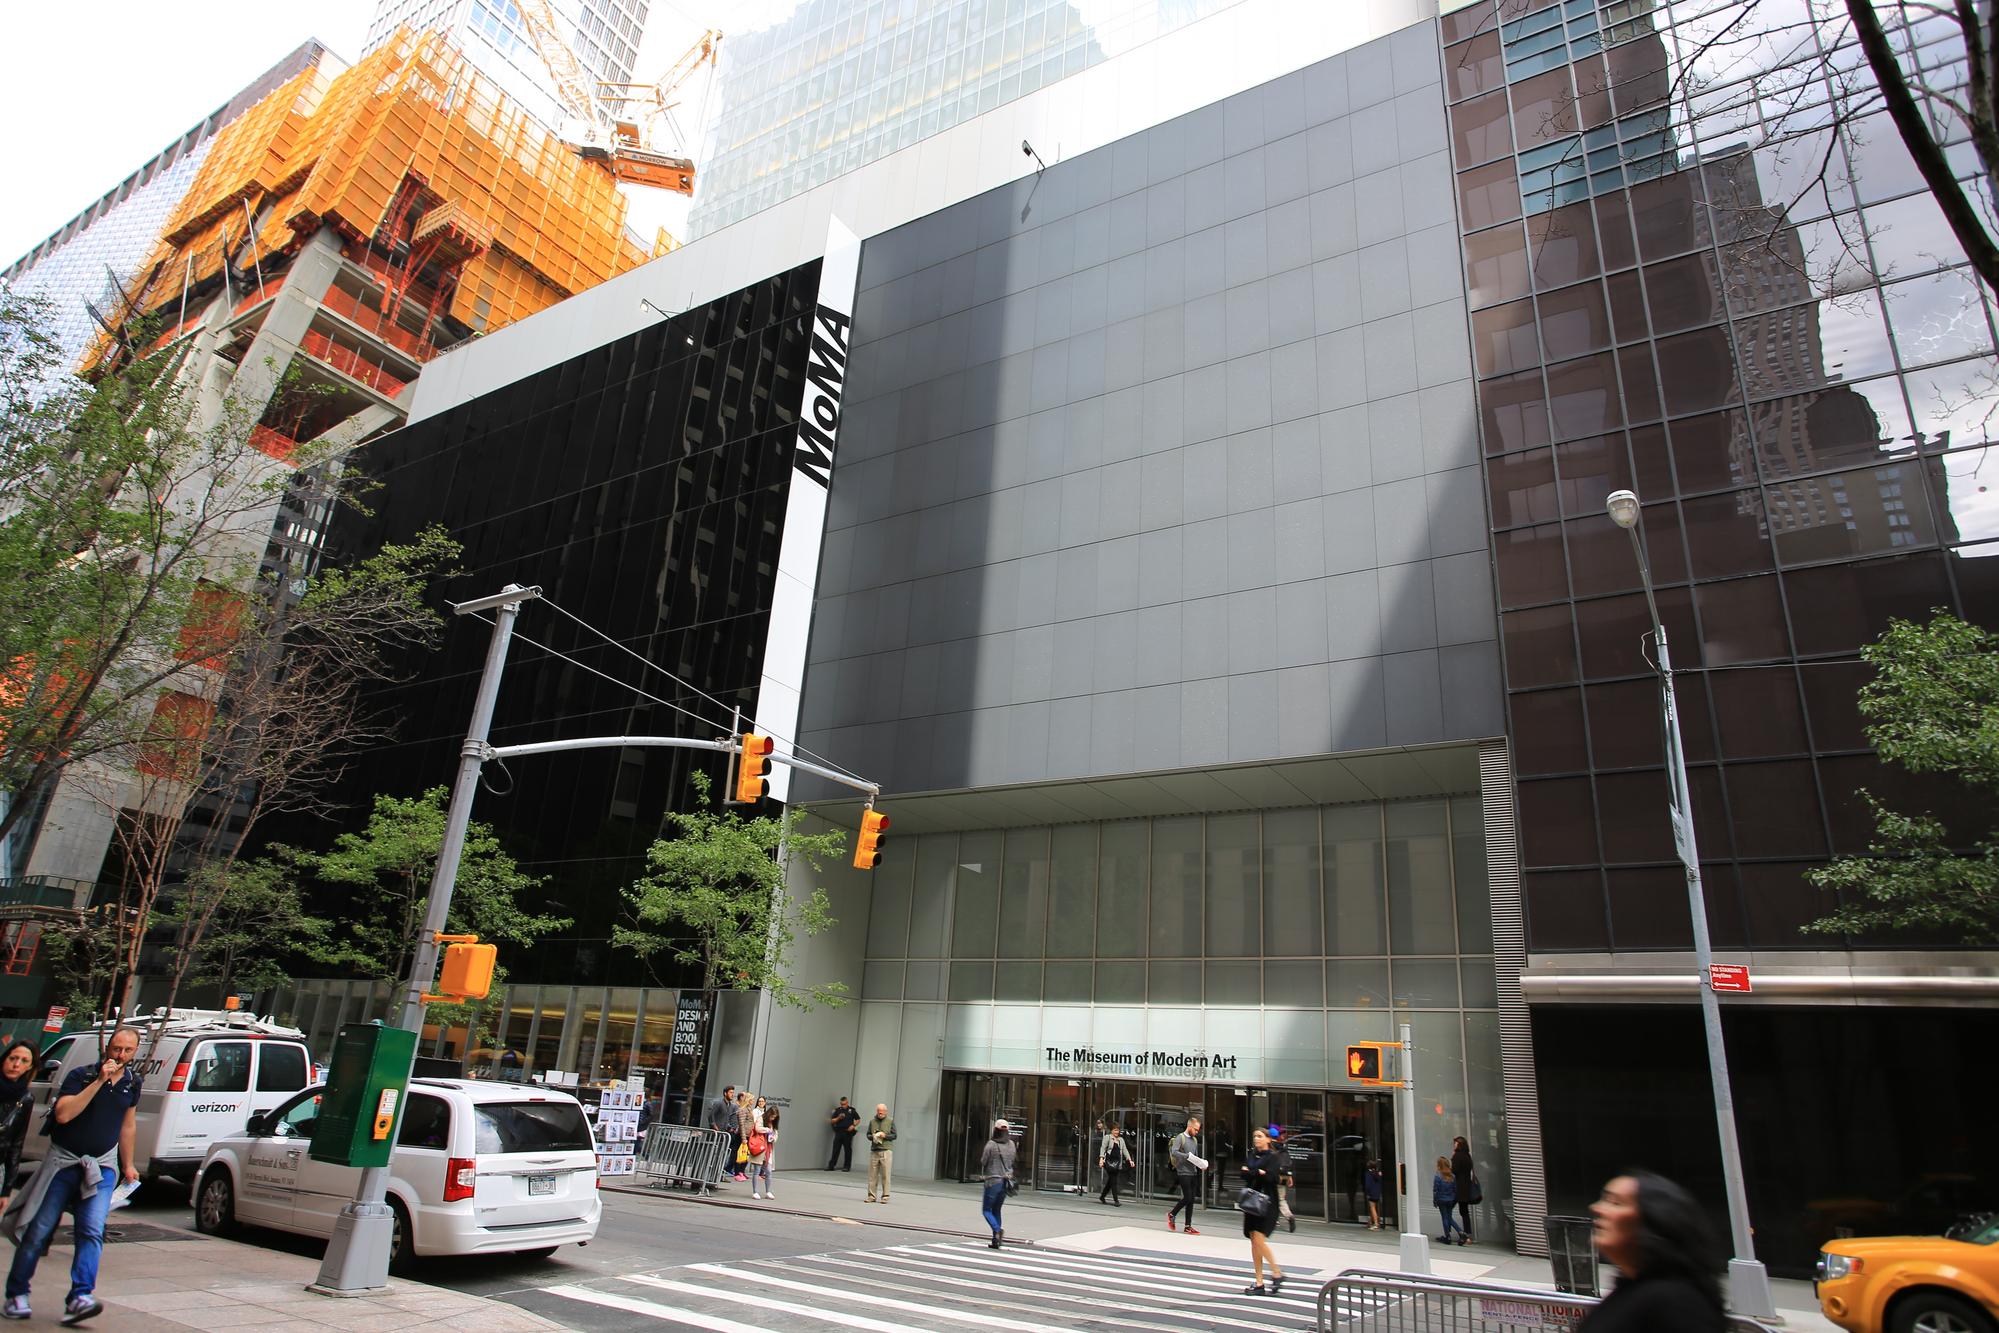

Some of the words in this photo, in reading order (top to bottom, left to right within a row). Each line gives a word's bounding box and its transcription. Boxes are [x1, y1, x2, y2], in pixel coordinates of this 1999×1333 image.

[639, 155, 667, 165] MORROW
[793, 303, 851, 490] MoMA
[676, 1021, 696, 1032] AND
[1046, 1047, 1071, 1062] The
[1073, 1048, 1132, 1064] Museum
[1135, 1051, 1149, 1065] of
[1152, 1052, 1208, 1067] Modern
[1211, 1054, 1236, 1069] Art
[191, 1101, 236, 1113] verizon
[1480, 1299, 1540, 1317] NATIONAL
[1481, 1310, 1539, 1321] RENT-A-FENCE
